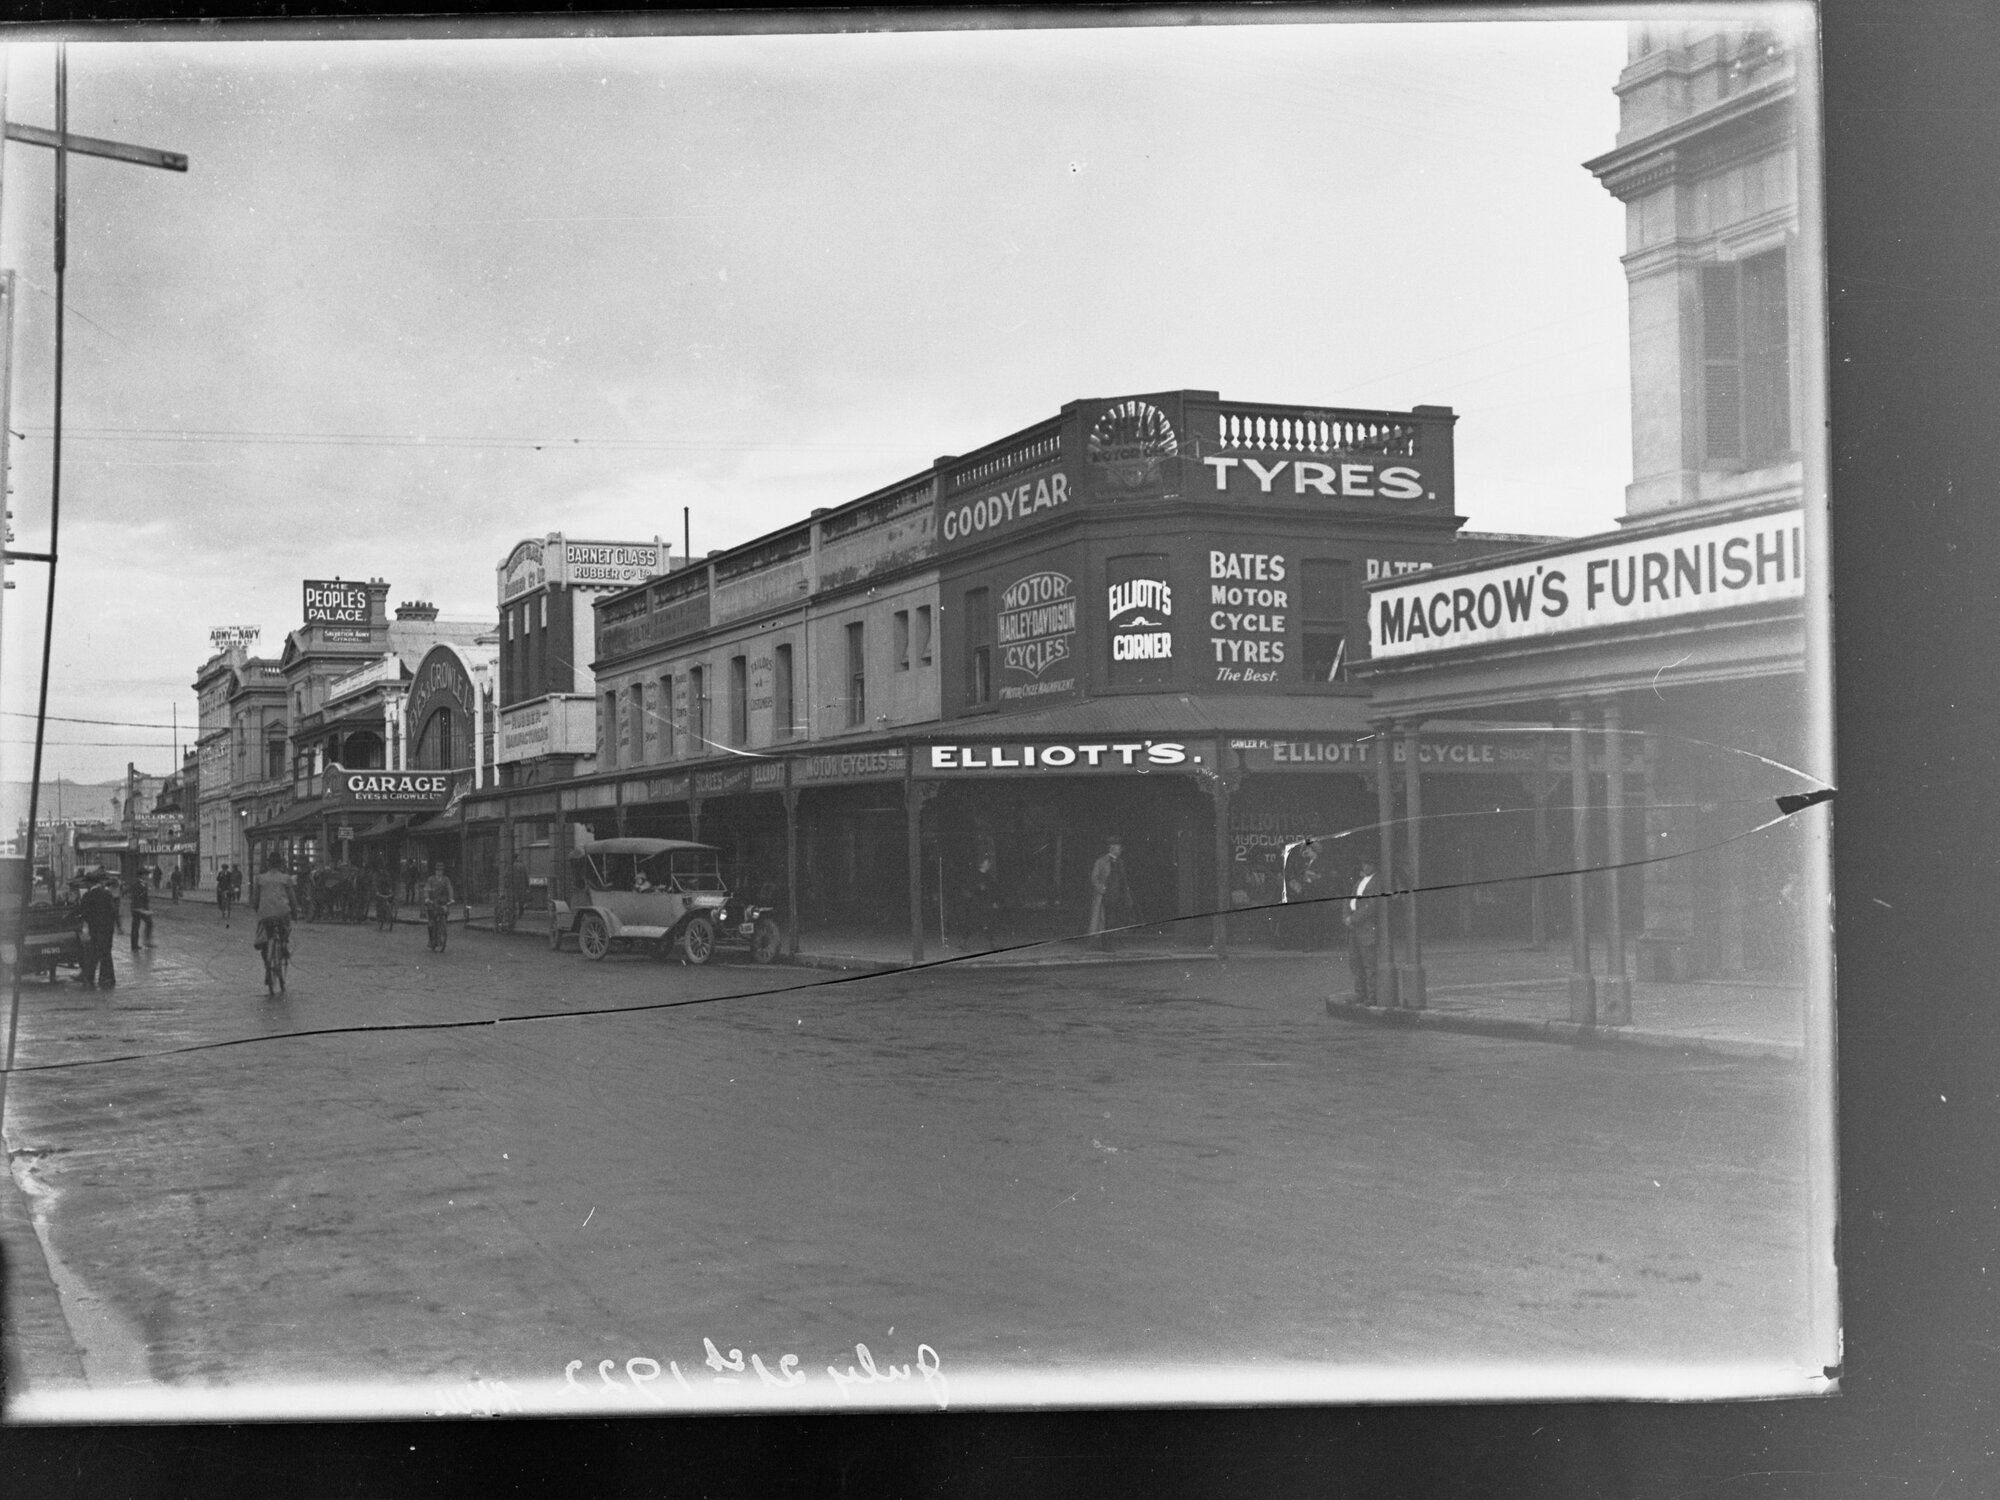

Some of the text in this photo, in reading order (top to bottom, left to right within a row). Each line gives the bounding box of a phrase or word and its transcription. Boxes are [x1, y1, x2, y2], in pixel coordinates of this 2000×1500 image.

[1204, 457, 1436, 500] TYRES.
[943, 473, 1069, 541] GOODYEAR
[567, 546, 656, 566] BARNET GLASS
[1210, 550, 1286, 582] BATES
[574, 567, 620, 580] RUBBER
[321, 582, 349, 590] THE
[1006, 576, 1066, 609] MOTOR
[1211, 584, 1288, 608] MOTOR
[306, 588, 366, 609] PEOPLE'S
[1108, 579, 1172, 621] ELLIOTT'S
[1380, 565, 1569, 645] MACROW'S
[308, 608, 368, 622] PALACE.
[999, 602, 1076, 643] HARLEY-DAVIDSON
[1210, 611, 1286, 632] CYCLE
[210, 630, 232, 641] ARMY
[239, 629, 260, 640] NAVY
[1113, 632, 1172, 661] CORNER
[1007, 639, 1065, 671] CYCLES
[1211, 637, 1286, 663] TYRES
[1216, 667, 1241, 682] The
[931, 740, 1201, 768] ELLIOTT'S.
[1231, 739, 1258, 749] GAWLER
[1273, 741, 1369, 762] ELLIOTT
[806, 756, 838, 778] MOTOR
[840, 753, 888, 775] CYCLES
[347, 775, 447, 792] GARAGE
[355, 793, 381, 801] EYES
[382, 793, 388, 801] &
[390, 792, 428, 801] CROWLE
